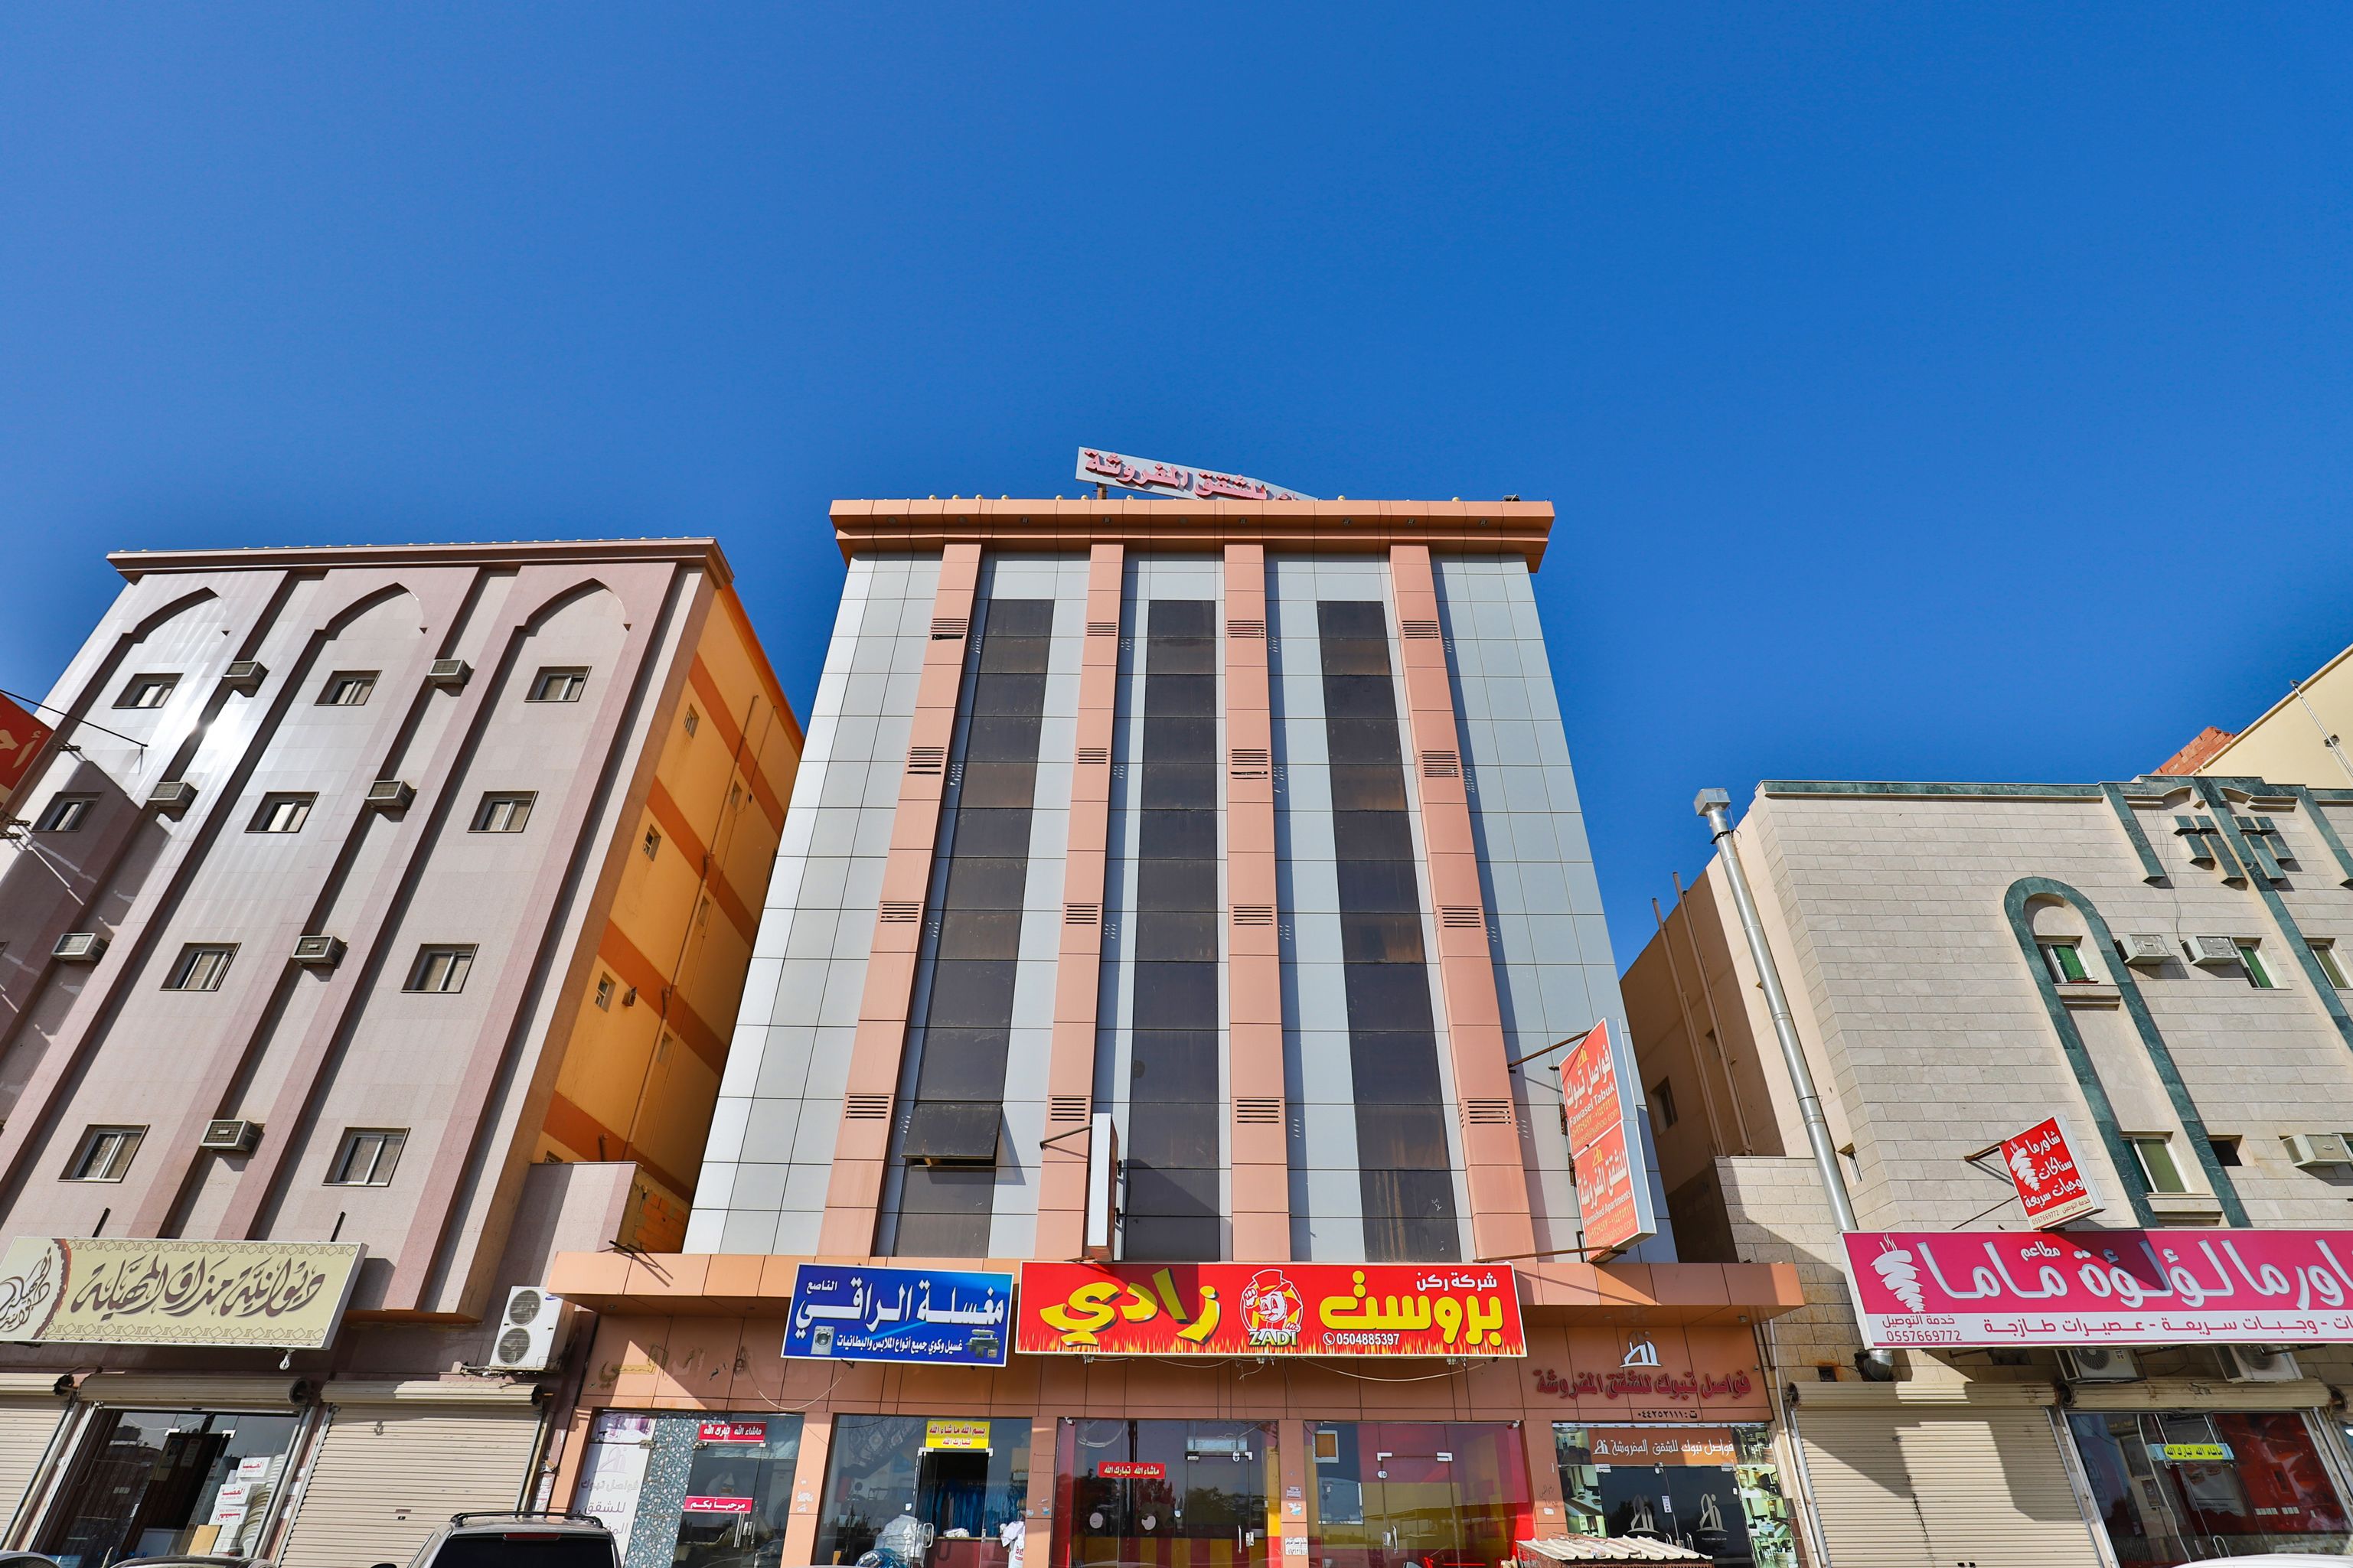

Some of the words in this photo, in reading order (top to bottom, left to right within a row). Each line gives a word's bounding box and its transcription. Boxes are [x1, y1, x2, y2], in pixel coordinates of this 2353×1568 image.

[1084, 448, 1189, 488] المفروشة
[1587, 1044, 1612, 1096] فواصل
[1566, 1069, 1586, 1110] تبوك
[1569, 1100, 1594, 1128] Fawasel
[1594, 1081, 1615, 1107] Tabuk
[2025, 1130, 2061, 1156] شاورما
[1607, 1149, 1628, 1197] للشقق
[2038, 1156, 2073, 1180] سناكات
[1578, 1165, 1607, 1210] المفروشة
[2052, 1178, 2084, 1197] وجبات
[1584, 1206, 1605, 1227] Furnished
[1604, 1189, 1631, 1214] Apartments
[2023, 1191, 2051, 1208] سريعة
[2062, 1202, 2077, 1214] التوصيل
[2078, 1198, 2090, 1206] خدمة
[2032, 1209, 2060, 1225] 0557669772
[2021, 1240, 2061, 1261] مطاعم
[1917, 1240, 2068, 1299] ماما
[2073, 1238, 2234, 1309] لؤلؤة
[2221, 1238, 2353, 1311] اورما
[806, 1280, 838, 1294] الناصع
[1416, 1272, 1448, 1292] ركن
[1451, 1272, 1497, 1289] شركة
[795, 1276, 913, 1339] الراقي
[916, 1279, 1004, 1325] مغسلة
[1039, 1267, 1221, 1347] زادي
[1319, 1270, 1504, 1348] بروست
[1882, 1315, 1923, 1328] التوصيل
[1926, 1315, 1956, 1325] خدمة
[1984, 1318, 2056, 1337] طازجة
[2062, 1317, 2146, 1338] عصيرات
[2161, 1316, 2237, 1336] سريعة
[2242, 1315, 2319, 1335] وجبات
[837, 1335, 873, 1351] والبطانيات
[873, 1336, 895, 1352] الملابس
[894, 1336, 911, 1352] أنواع
[1248, 1330, 1297, 1347] ZADI
[1336, 1333, 1400, 1345] 0504885397
[1886, 1330, 1963, 1342] 0557669772
[911, 1341, 928, 1354] جميع
[928, 1339, 945, 1354] وكوي
[945, 1339, 963, 1354] غسيل
[1532, 1368, 1605, 1400] المفروشة
[1606, 1370, 1653, 1400] للشقق
[1654, 1371, 1699, 1401] تبوك
[1702, 1370, 1754, 1400] فواصل
[1638, 1410, 1683, 1419] ٠٤٤٢٥٢١١١
[704, 1424, 713, 1435] الله
[714, 1426, 731, 1437] تبارك
[734, 1425, 744, 1436] الله
[928, 1425, 939, 1434] الله
[961, 1425, 971, 1434] الله
[972, 1428, 985, 1437] بسم
[953, 1438, 971, 1446] تبارك
[1610, 1438, 1649, 1456] المفروشة
[1652, 1439, 1679, 1456] للشقق
[1681, 1439, 1702, 1456] تبوك
[1704, 1438, 1735, 1456] فواصل
[2167, 1446, 2176, 1456] الله
[2177, 1446, 2193, 1458] تبارك
[2195, 1446, 2205, 1456] الله
[1104, 1464, 1113, 1474] الله
[1114, 1465, 1131, 1476] تبارك
[1134, 1464, 1143, 1475] الله
[580, 1478, 605, 1491] تبوك
[607, 1478, 639, 1491] فواصل
[585, 1501, 626, 1515] للشقق
[690, 1500, 713, 1510] بكم
